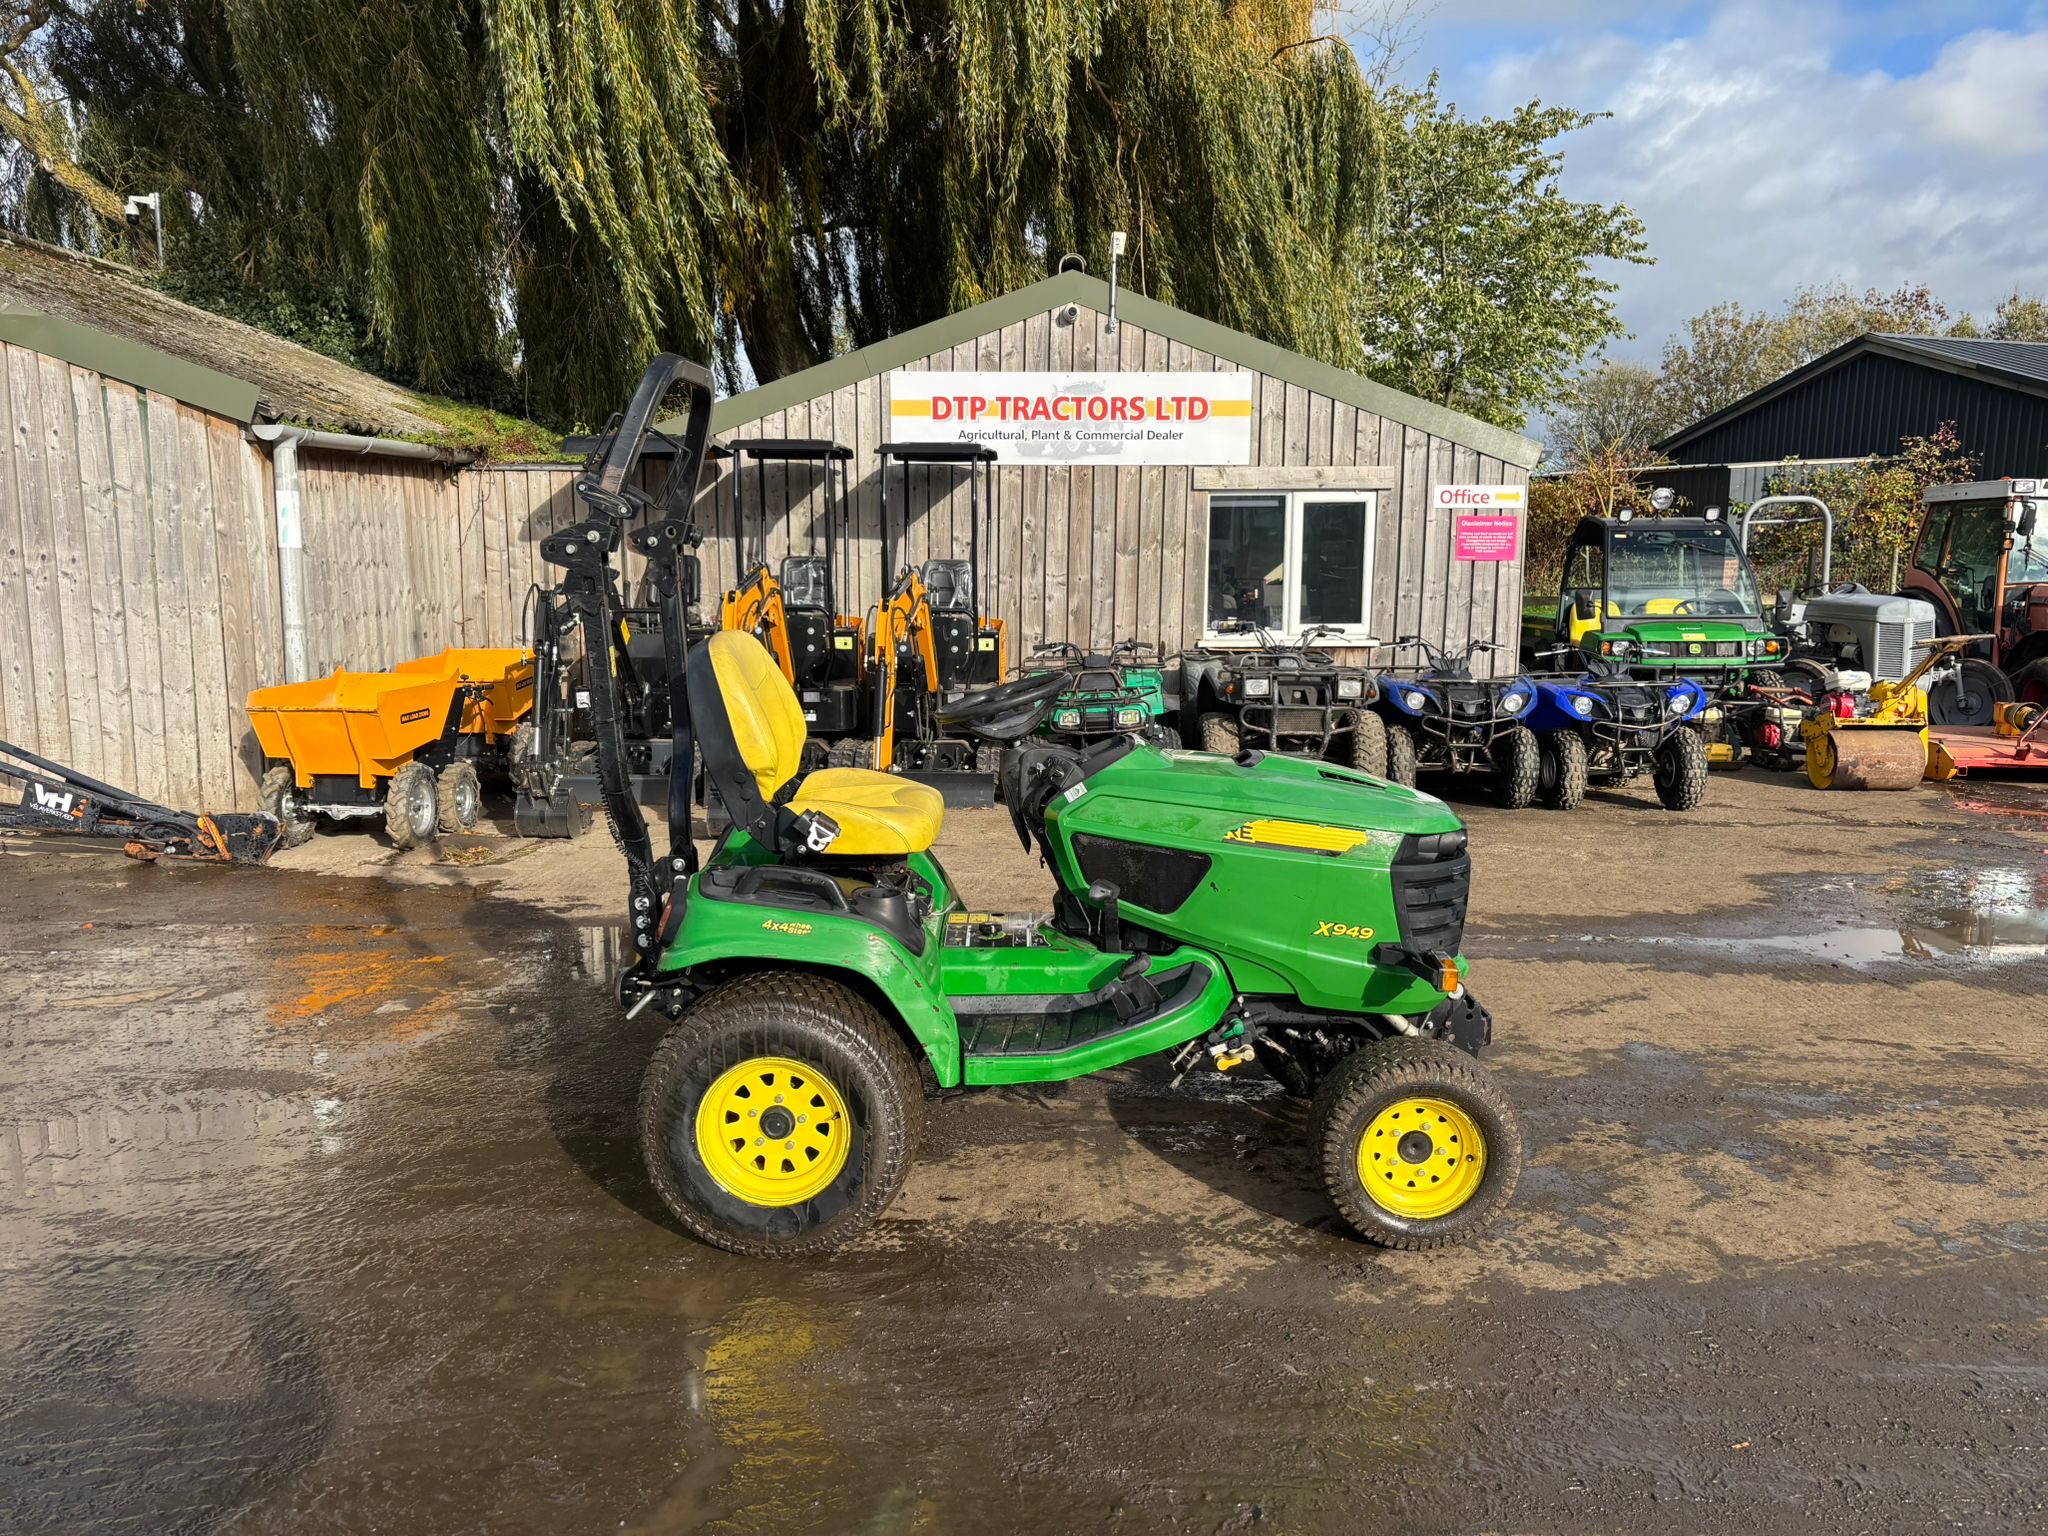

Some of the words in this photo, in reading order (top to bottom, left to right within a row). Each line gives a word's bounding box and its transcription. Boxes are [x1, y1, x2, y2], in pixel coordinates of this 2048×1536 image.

[931, 396, 987, 421] DTP
[995, 395, 1146, 422] TRACTORS
[1155, 396, 1209, 421] LTD
[958, 429, 1028, 443] Agricultural,
[1031, 429, 1060, 440] Plant
[1063, 430, 1073, 441] &
[1075, 429, 1144, 441] Commercial
[1147, 429, 1184, 441] Dealer
[1439, 489, 1490, 504] Office
[761, 919, 789, 932] 4x4
[1312, 920, 1375, 940] X949
